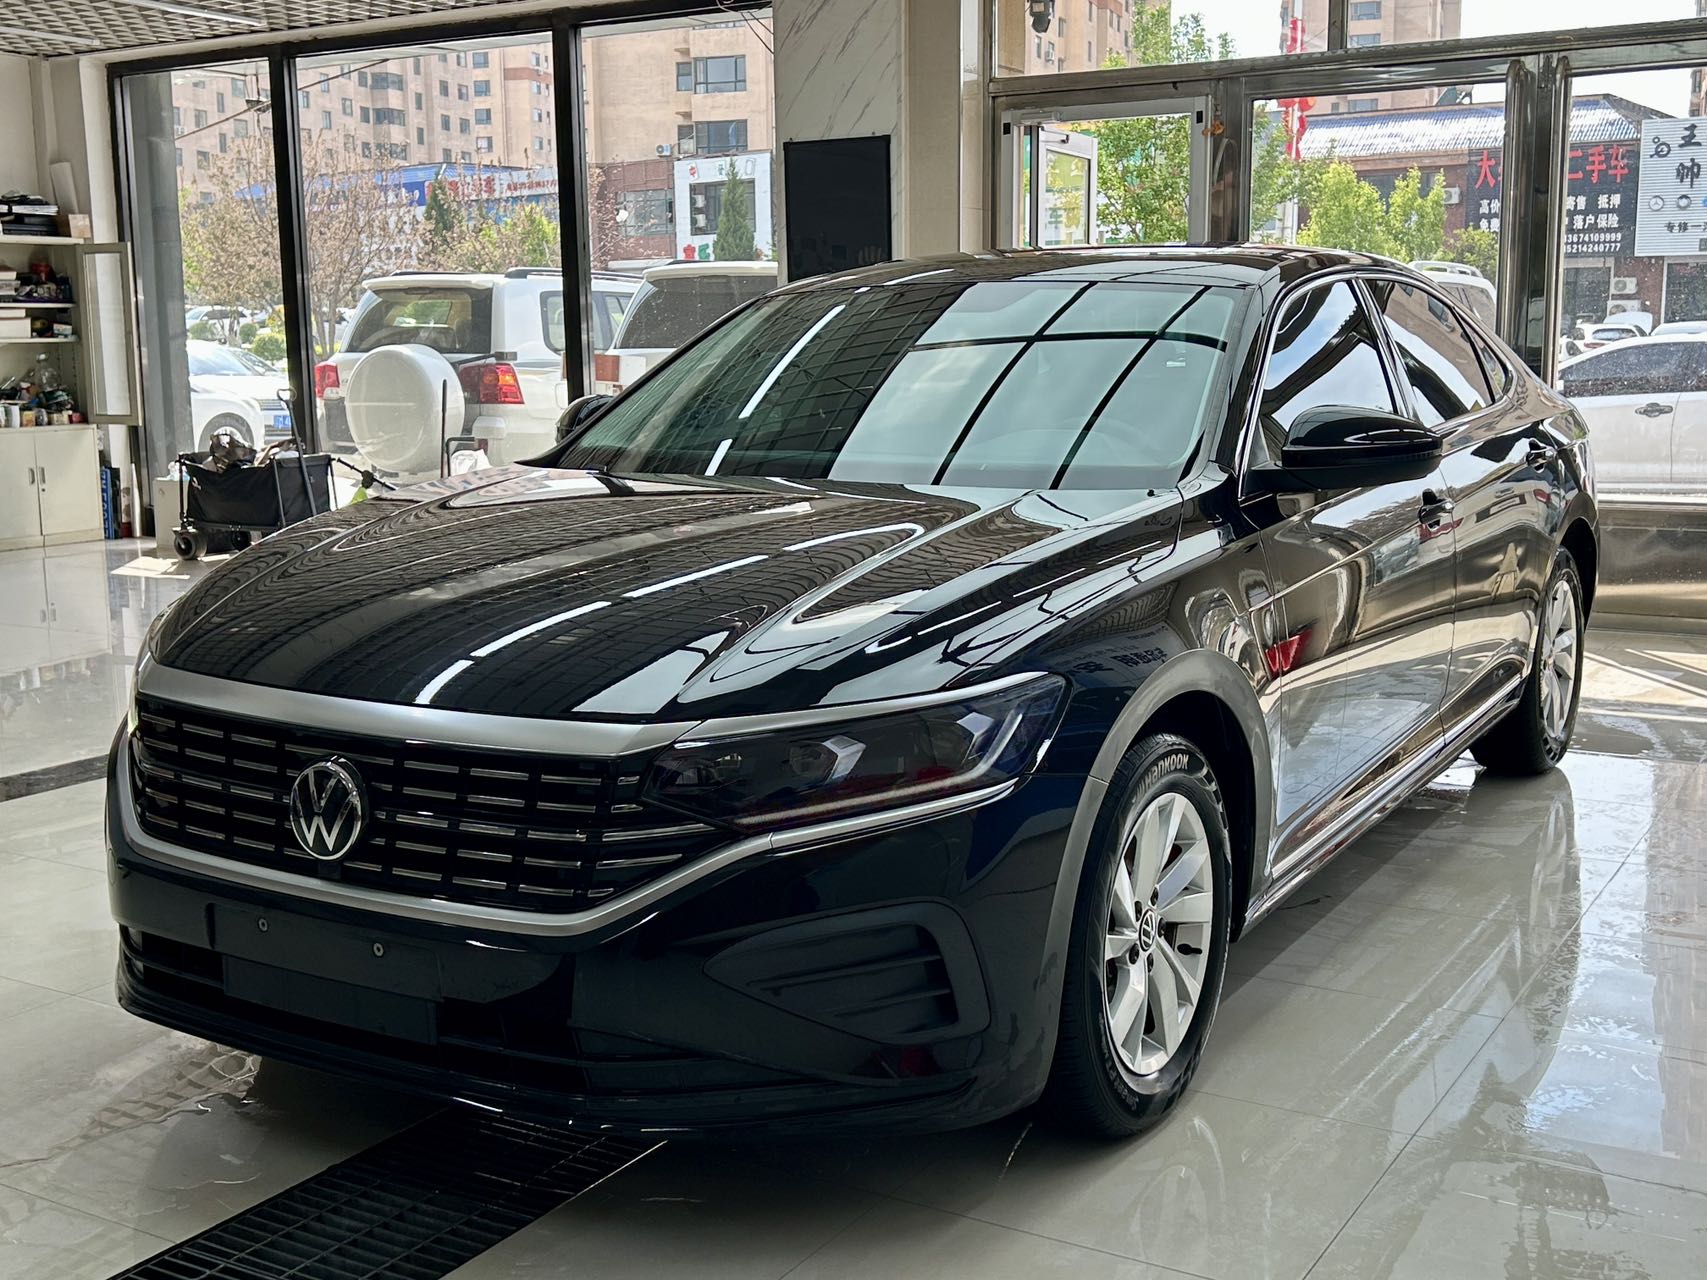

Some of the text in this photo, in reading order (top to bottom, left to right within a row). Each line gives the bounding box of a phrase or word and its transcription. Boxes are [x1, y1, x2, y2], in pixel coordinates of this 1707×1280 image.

[1475, 145, 1629, 189] 大 二手车
[1479, 198, 1501, 214] 高价
[1597, 193, 1621, 210] 抵押
[1573, 213, 1619, 230] 落户保险
